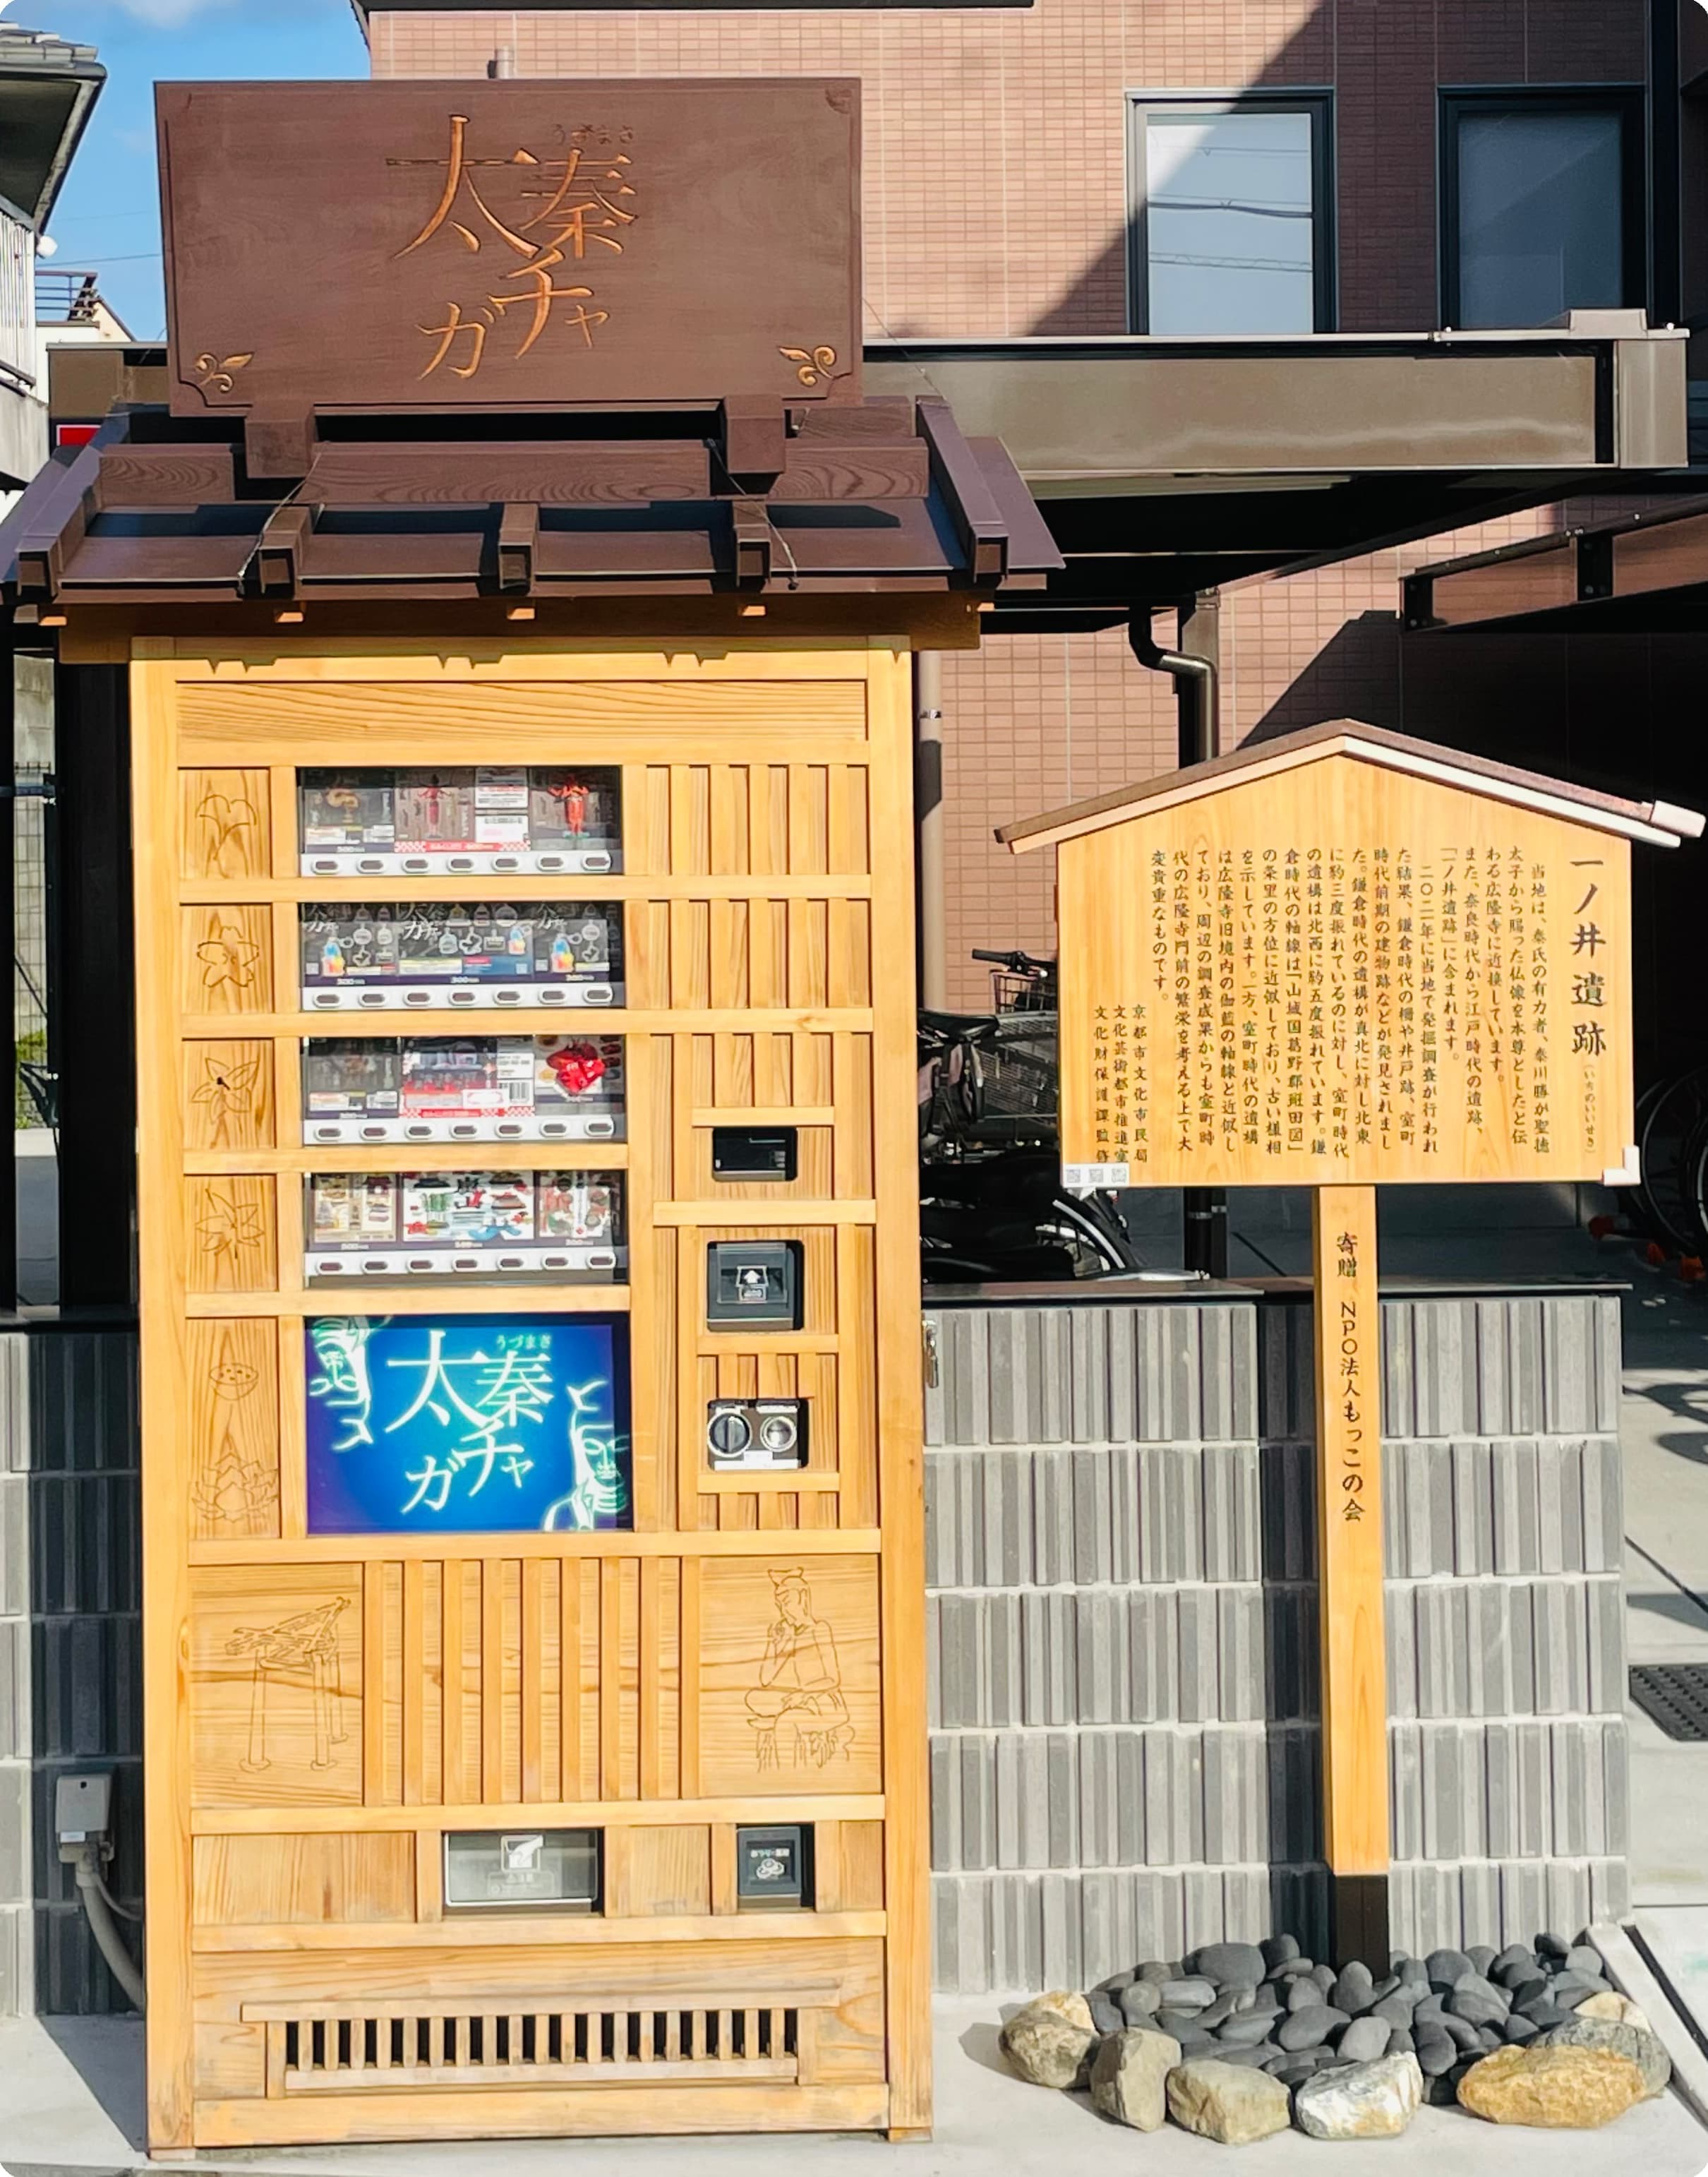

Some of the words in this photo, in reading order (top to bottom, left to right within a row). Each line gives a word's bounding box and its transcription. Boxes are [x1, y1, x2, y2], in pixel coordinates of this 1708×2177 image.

[385, 114, 639, 261] 太秦
[414, 247, 610, 381] ガチャ
[1570, 860, 1607, 1057] 一ノ井遺跡
[1336, 1232, 1358, 1278] 寄贈
[385, 1329, 555, 1434] 太秦
[1340, 1301, 1366, 1522] NPO法人もっこの会
[400, 1414, 535, 1514] ガチャ
